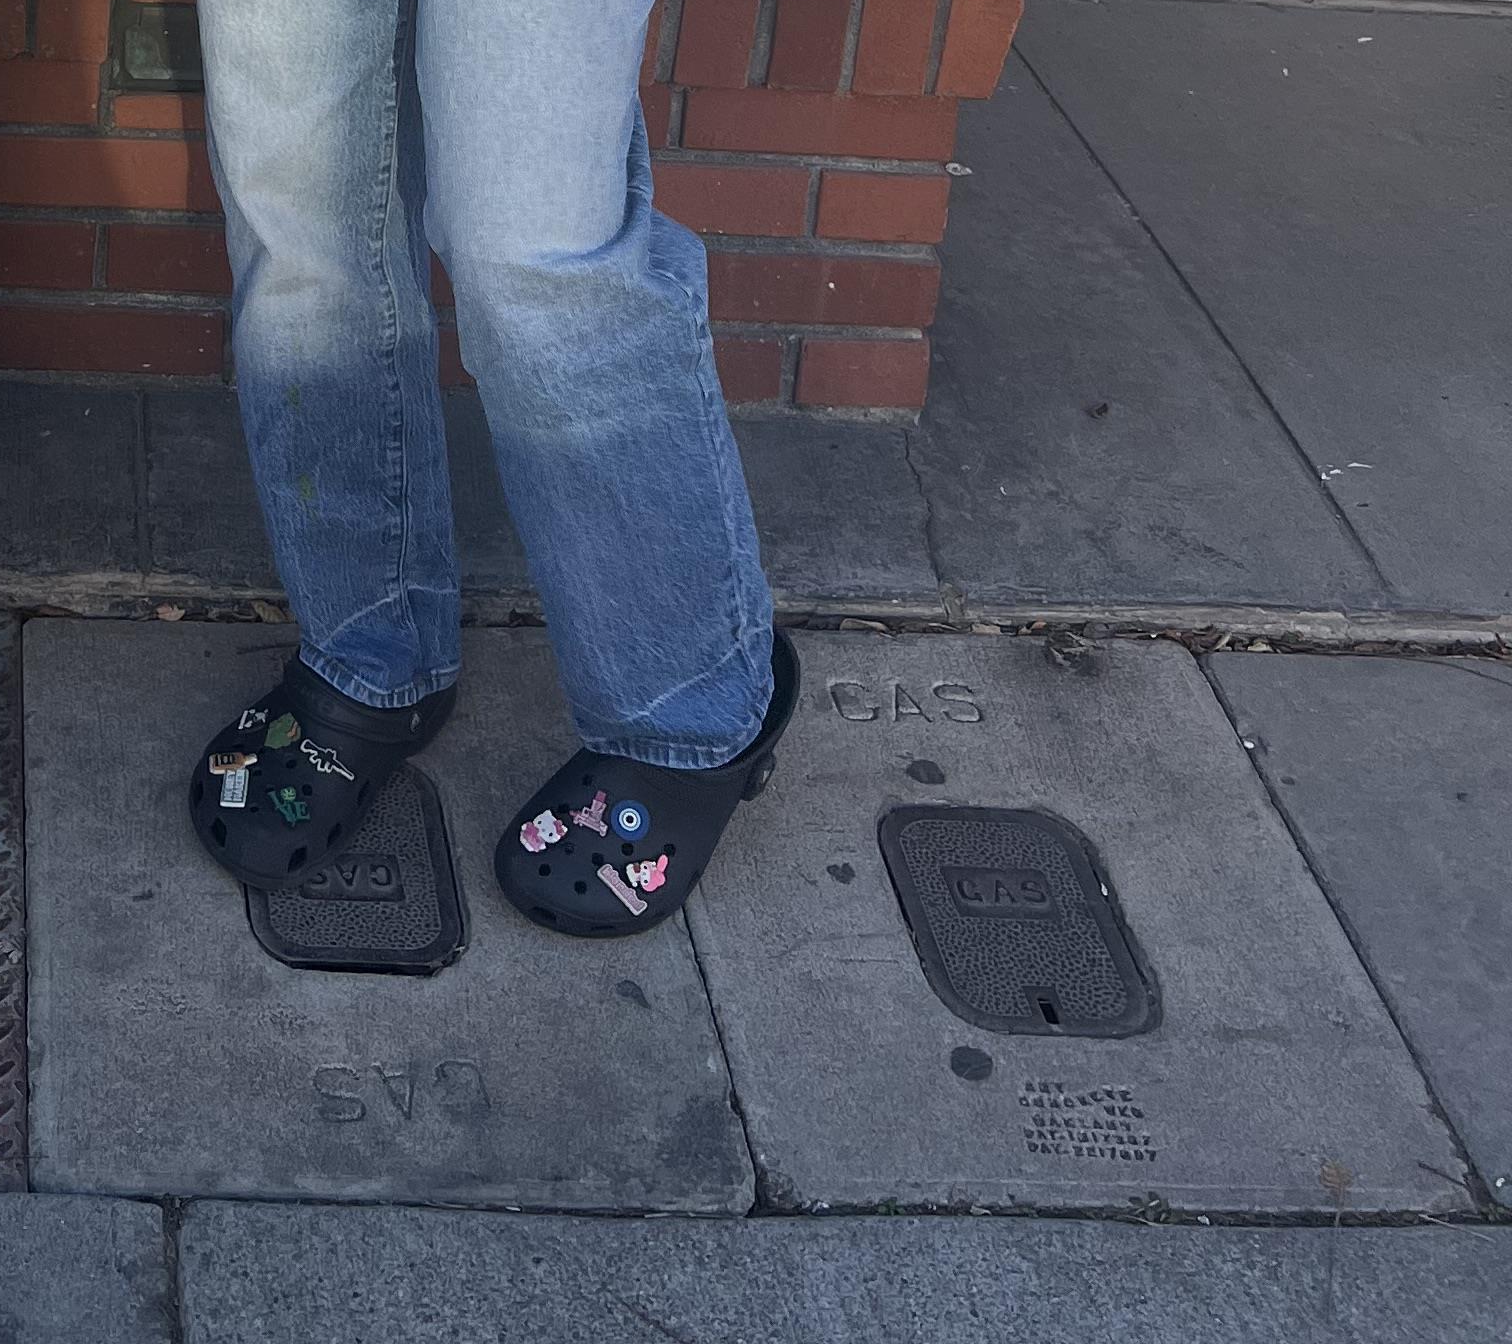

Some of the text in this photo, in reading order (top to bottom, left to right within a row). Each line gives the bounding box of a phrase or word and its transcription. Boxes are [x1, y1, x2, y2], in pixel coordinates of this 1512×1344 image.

[826, 678, 984, 723] GAS
[956, 875, 1049, 907] GAS
[311, 1060, 493, 1123] GAS
